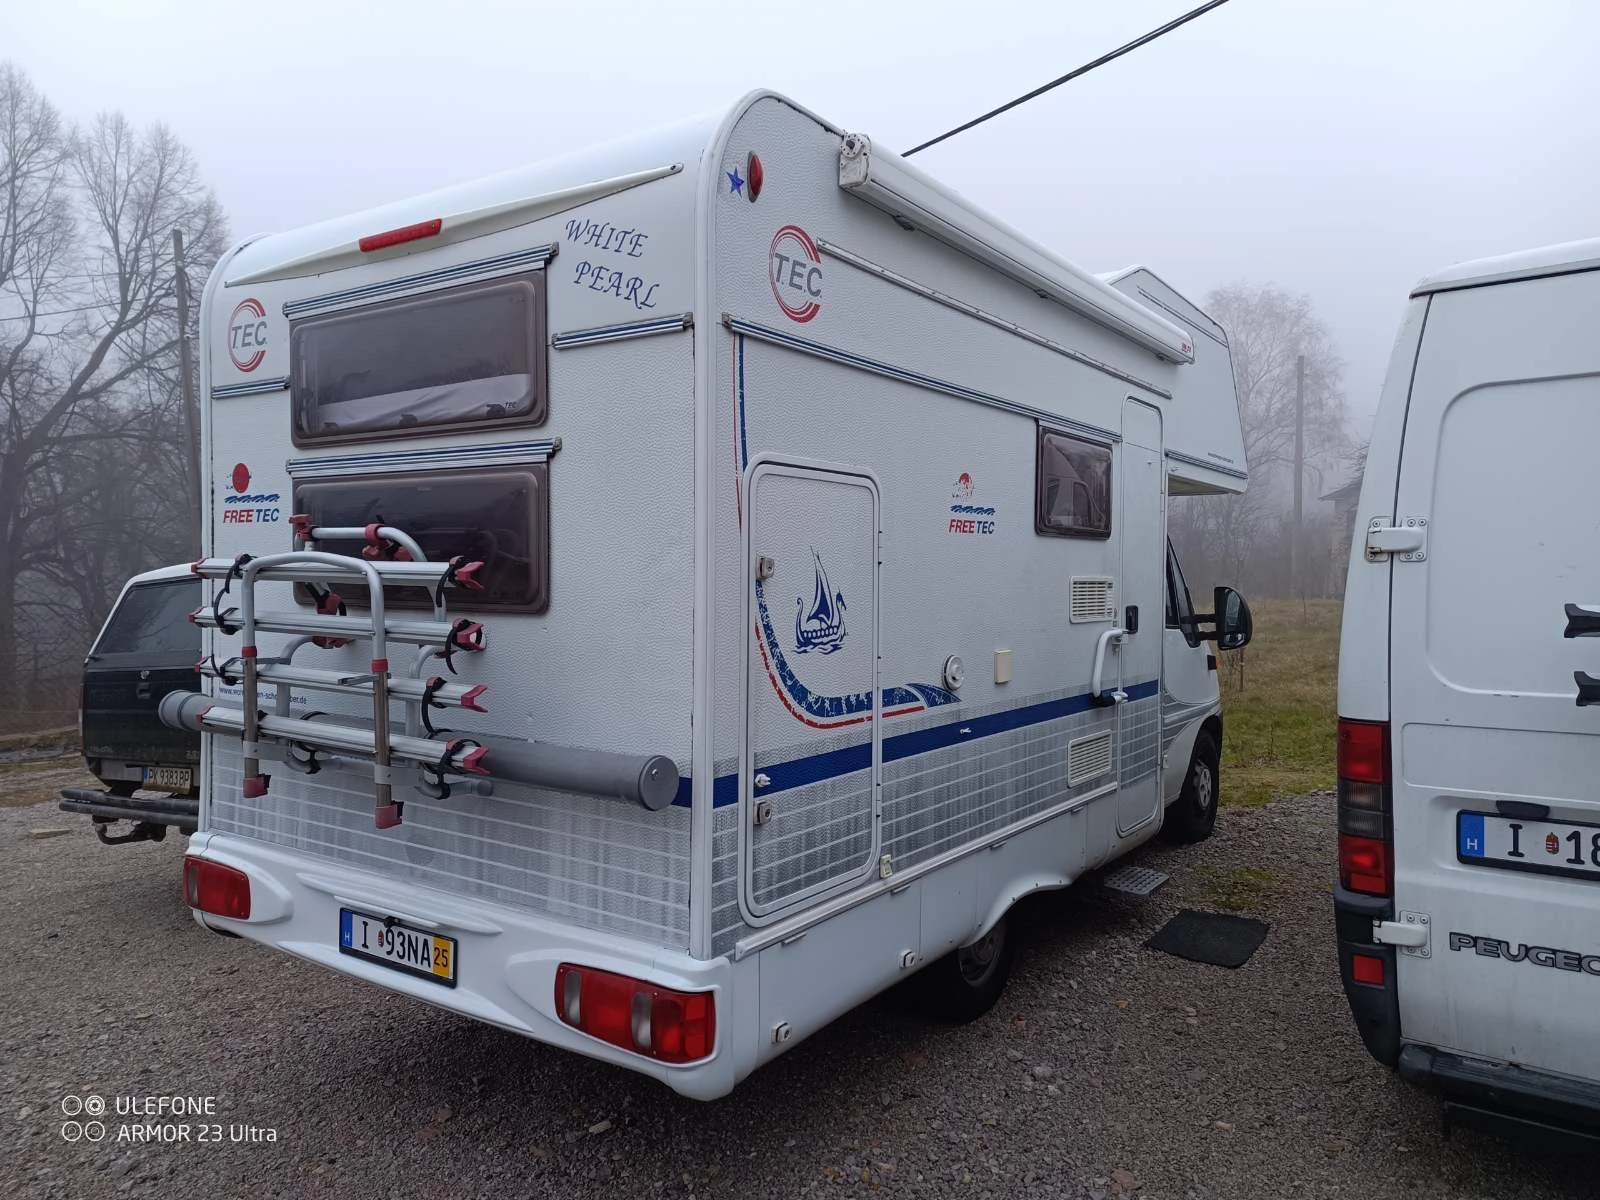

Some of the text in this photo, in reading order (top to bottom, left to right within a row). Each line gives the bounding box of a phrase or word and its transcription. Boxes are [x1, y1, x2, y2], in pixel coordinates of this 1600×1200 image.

[565, 219, 649, 258] WHITE
[573, 260, 660, 310] PEARL
[223, 508, 280, 523] FREE TEC
[949, 519, 995, 535] FREE TEC
[1466, 837, 1478, 851] H
[1507, 823, 1525, 858] I
[344, 920, 449, 969] H I 93NA 25
